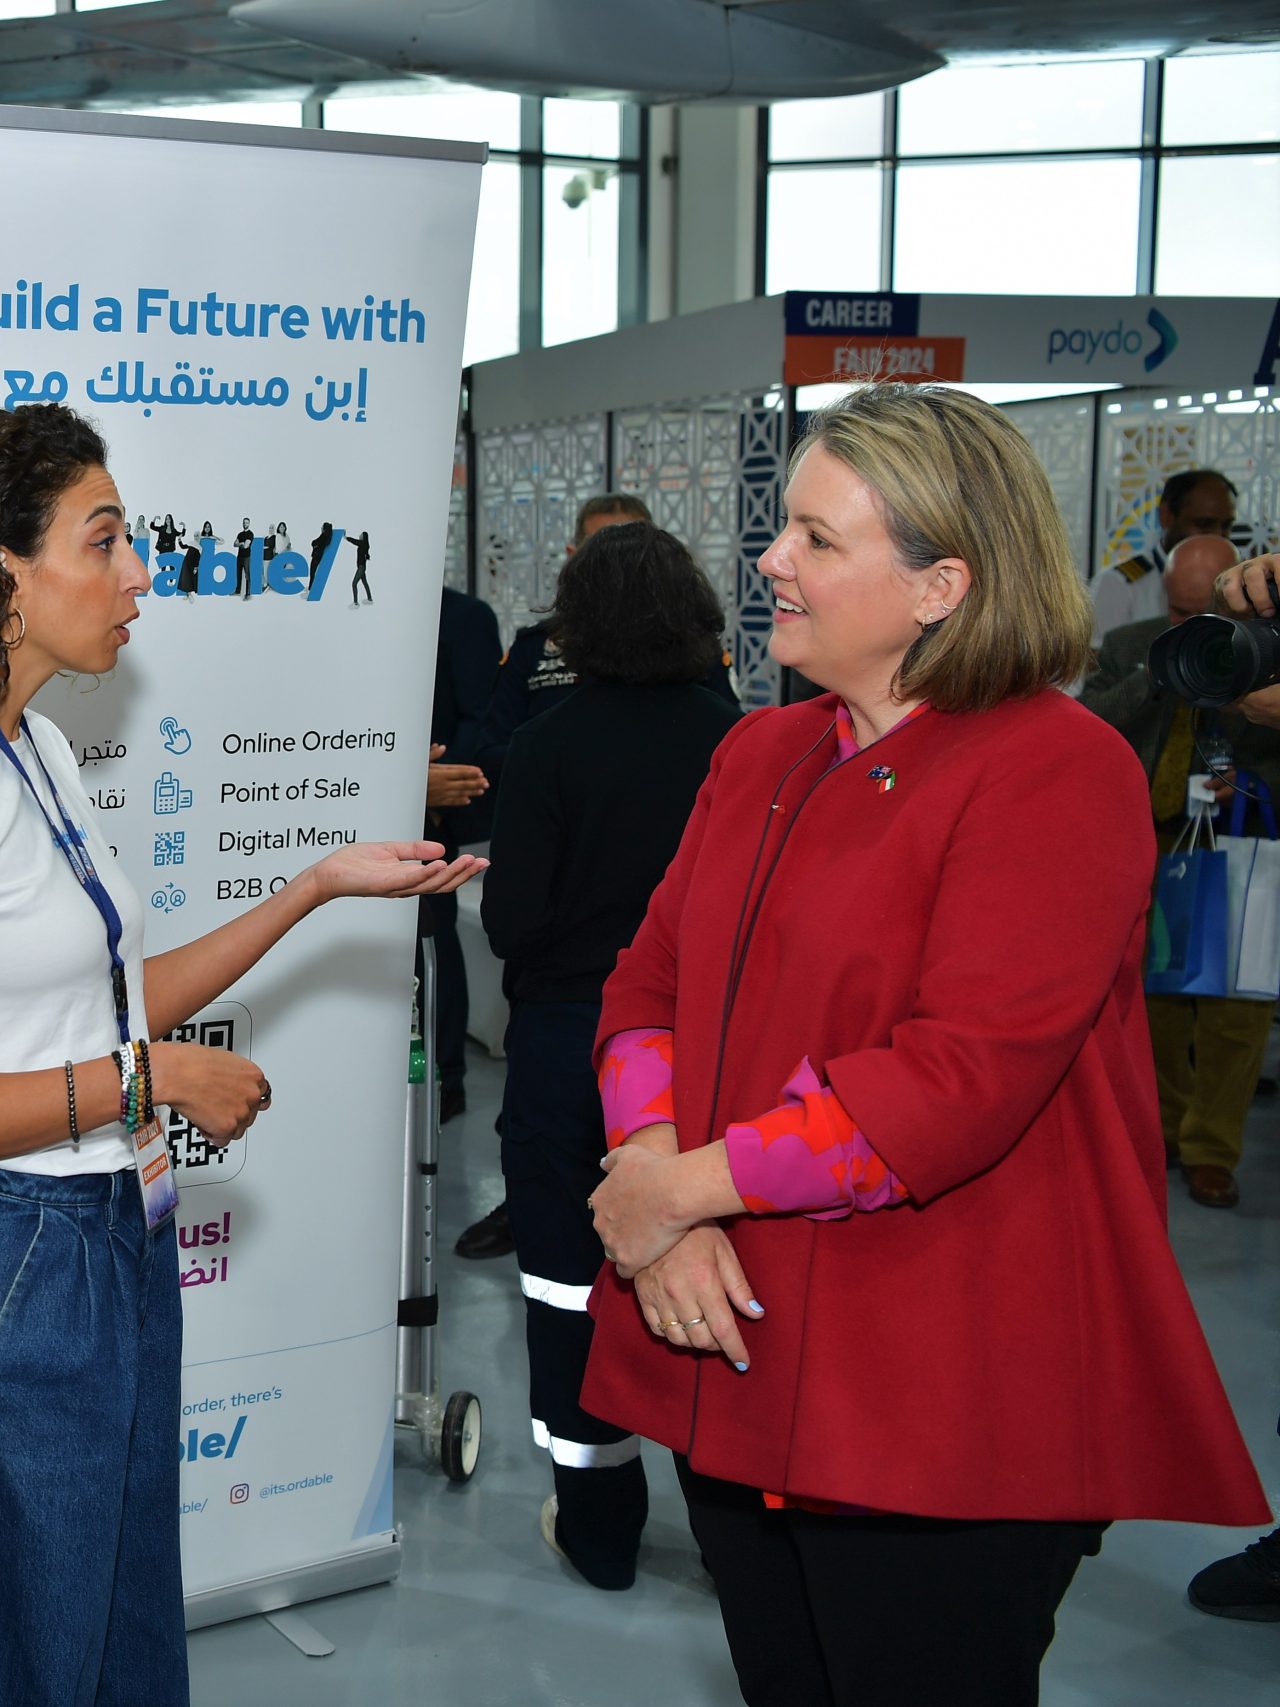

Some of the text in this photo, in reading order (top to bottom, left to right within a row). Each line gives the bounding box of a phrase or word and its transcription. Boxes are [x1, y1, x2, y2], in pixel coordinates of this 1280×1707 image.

[92, 297, 122, 332] a
[136, 287, 310, 339] Future
[321, 295, 426, 343] with
[805, 299, 893, 327] CAREER
[1048, 320, 1142, 365] paydo
[3, 360, 368, 423] إبن مستقبلك مع
[78, 740, 127, 767] متجر
[222, 728, 396, 755] Online Ordering
[220, 777, 361, 803] Point of Sale
[219, 827, 357, 856] Digital Menu
[217, 878, 263, 900] B2B
[178, 1212, 231, 1249] us!
[182, 1386, 282, 1415] order, there's
[259, 1473, 333, 1498] @its.ordable
